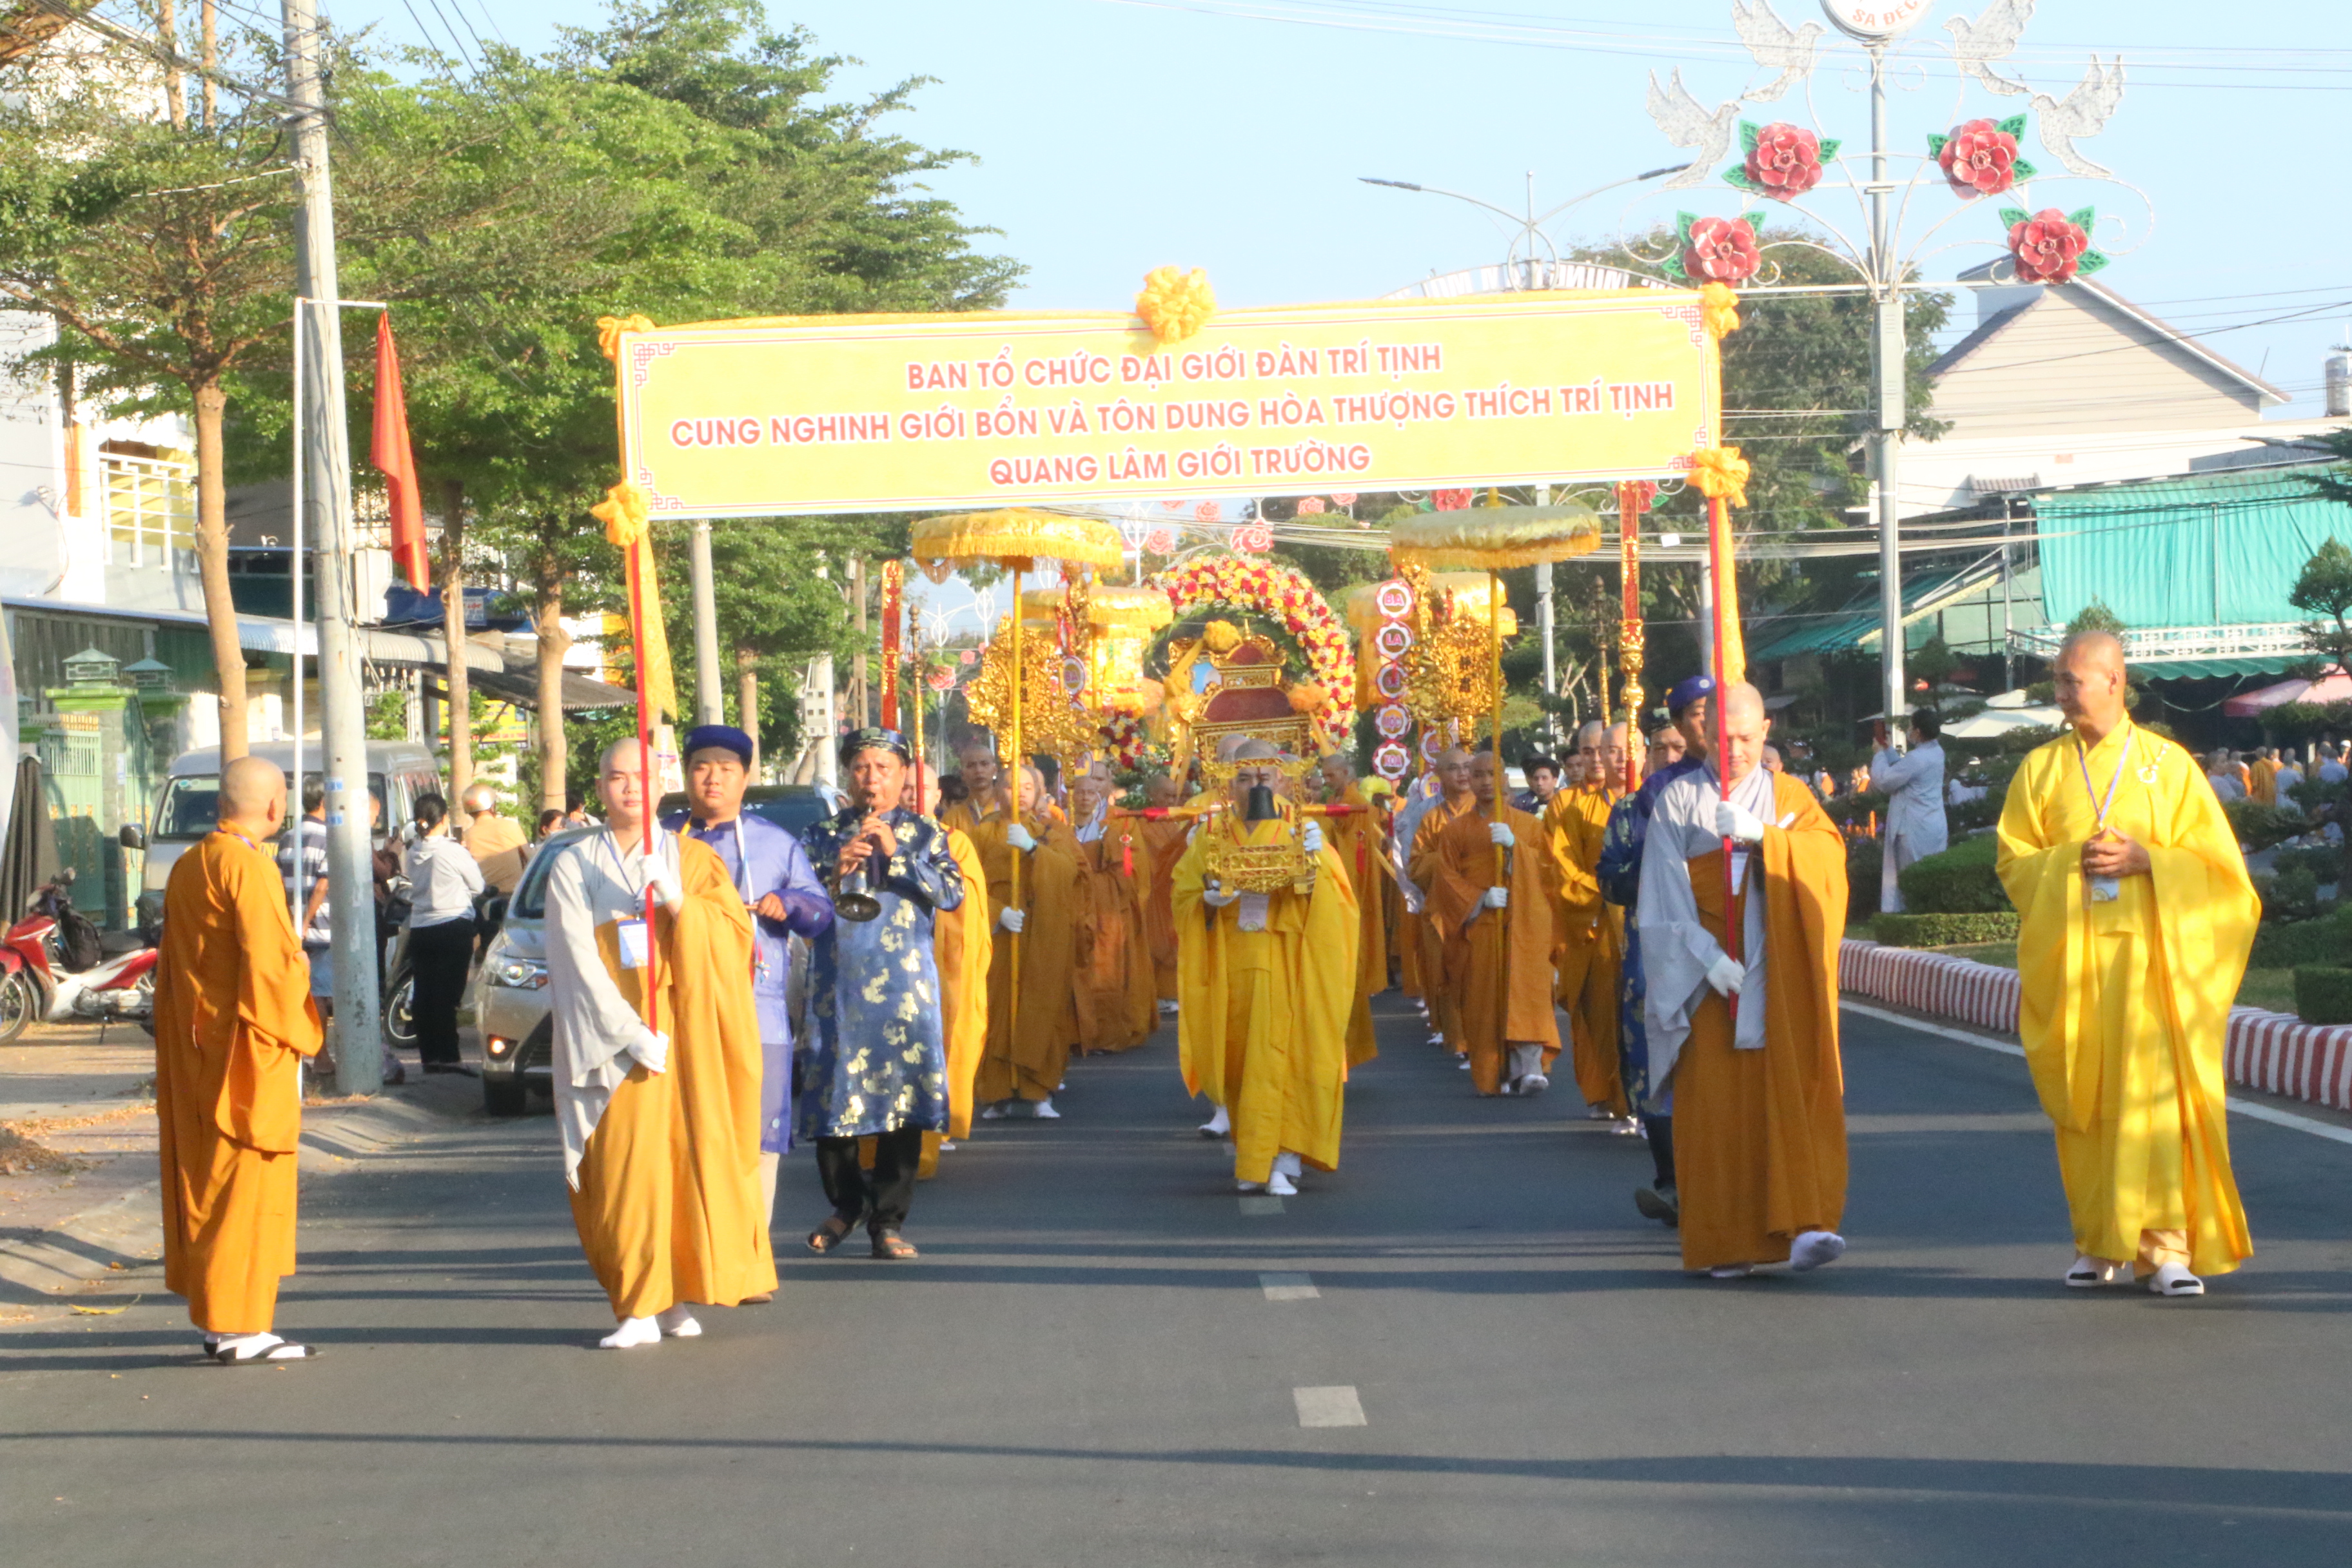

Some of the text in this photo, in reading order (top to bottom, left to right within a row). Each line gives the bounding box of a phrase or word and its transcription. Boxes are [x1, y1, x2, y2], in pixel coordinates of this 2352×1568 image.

[1852, 0, 1918, 26] SA ĐÉC
[909, 340, 1441, 389] BAN TỔ CHỨC ĐẠI GIỚI ĐÀN TRÍ TỊNH
[671, 379, 1673, 446] CUNG NGHINH GIỚI BỔN VÀ TÔN DUNG HÒA THƯỢNG THÍCH TRÍ TỊNH
[990, 440, 1371, 485] QUANG LÂM GIỚI TRƯỜNG
[1384, 592, 1405, 607] BA
[1385, 632, 1404, 646] LA
